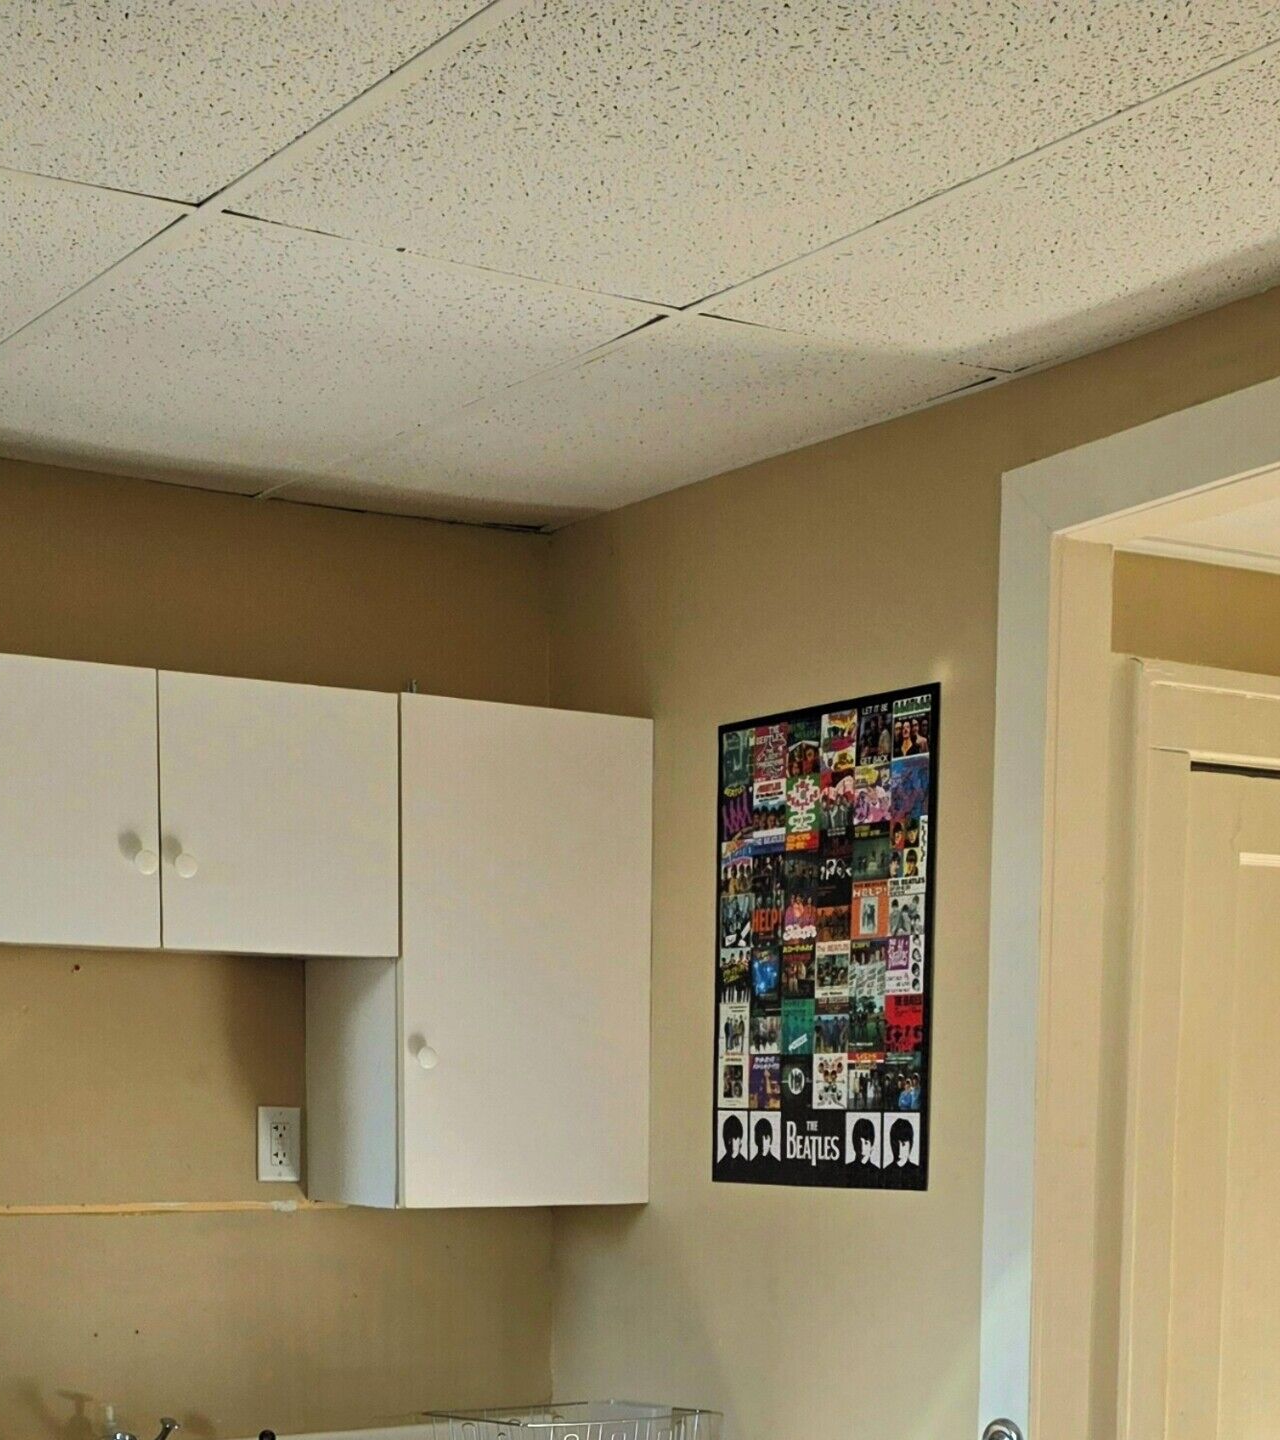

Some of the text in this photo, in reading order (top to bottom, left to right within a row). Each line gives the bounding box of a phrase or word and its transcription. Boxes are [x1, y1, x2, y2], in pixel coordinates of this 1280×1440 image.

[861, 705, 873, 715] LET
[807, 1120, 818, 1131] THE
[786, 1121, 840, 1166] BEATLES
